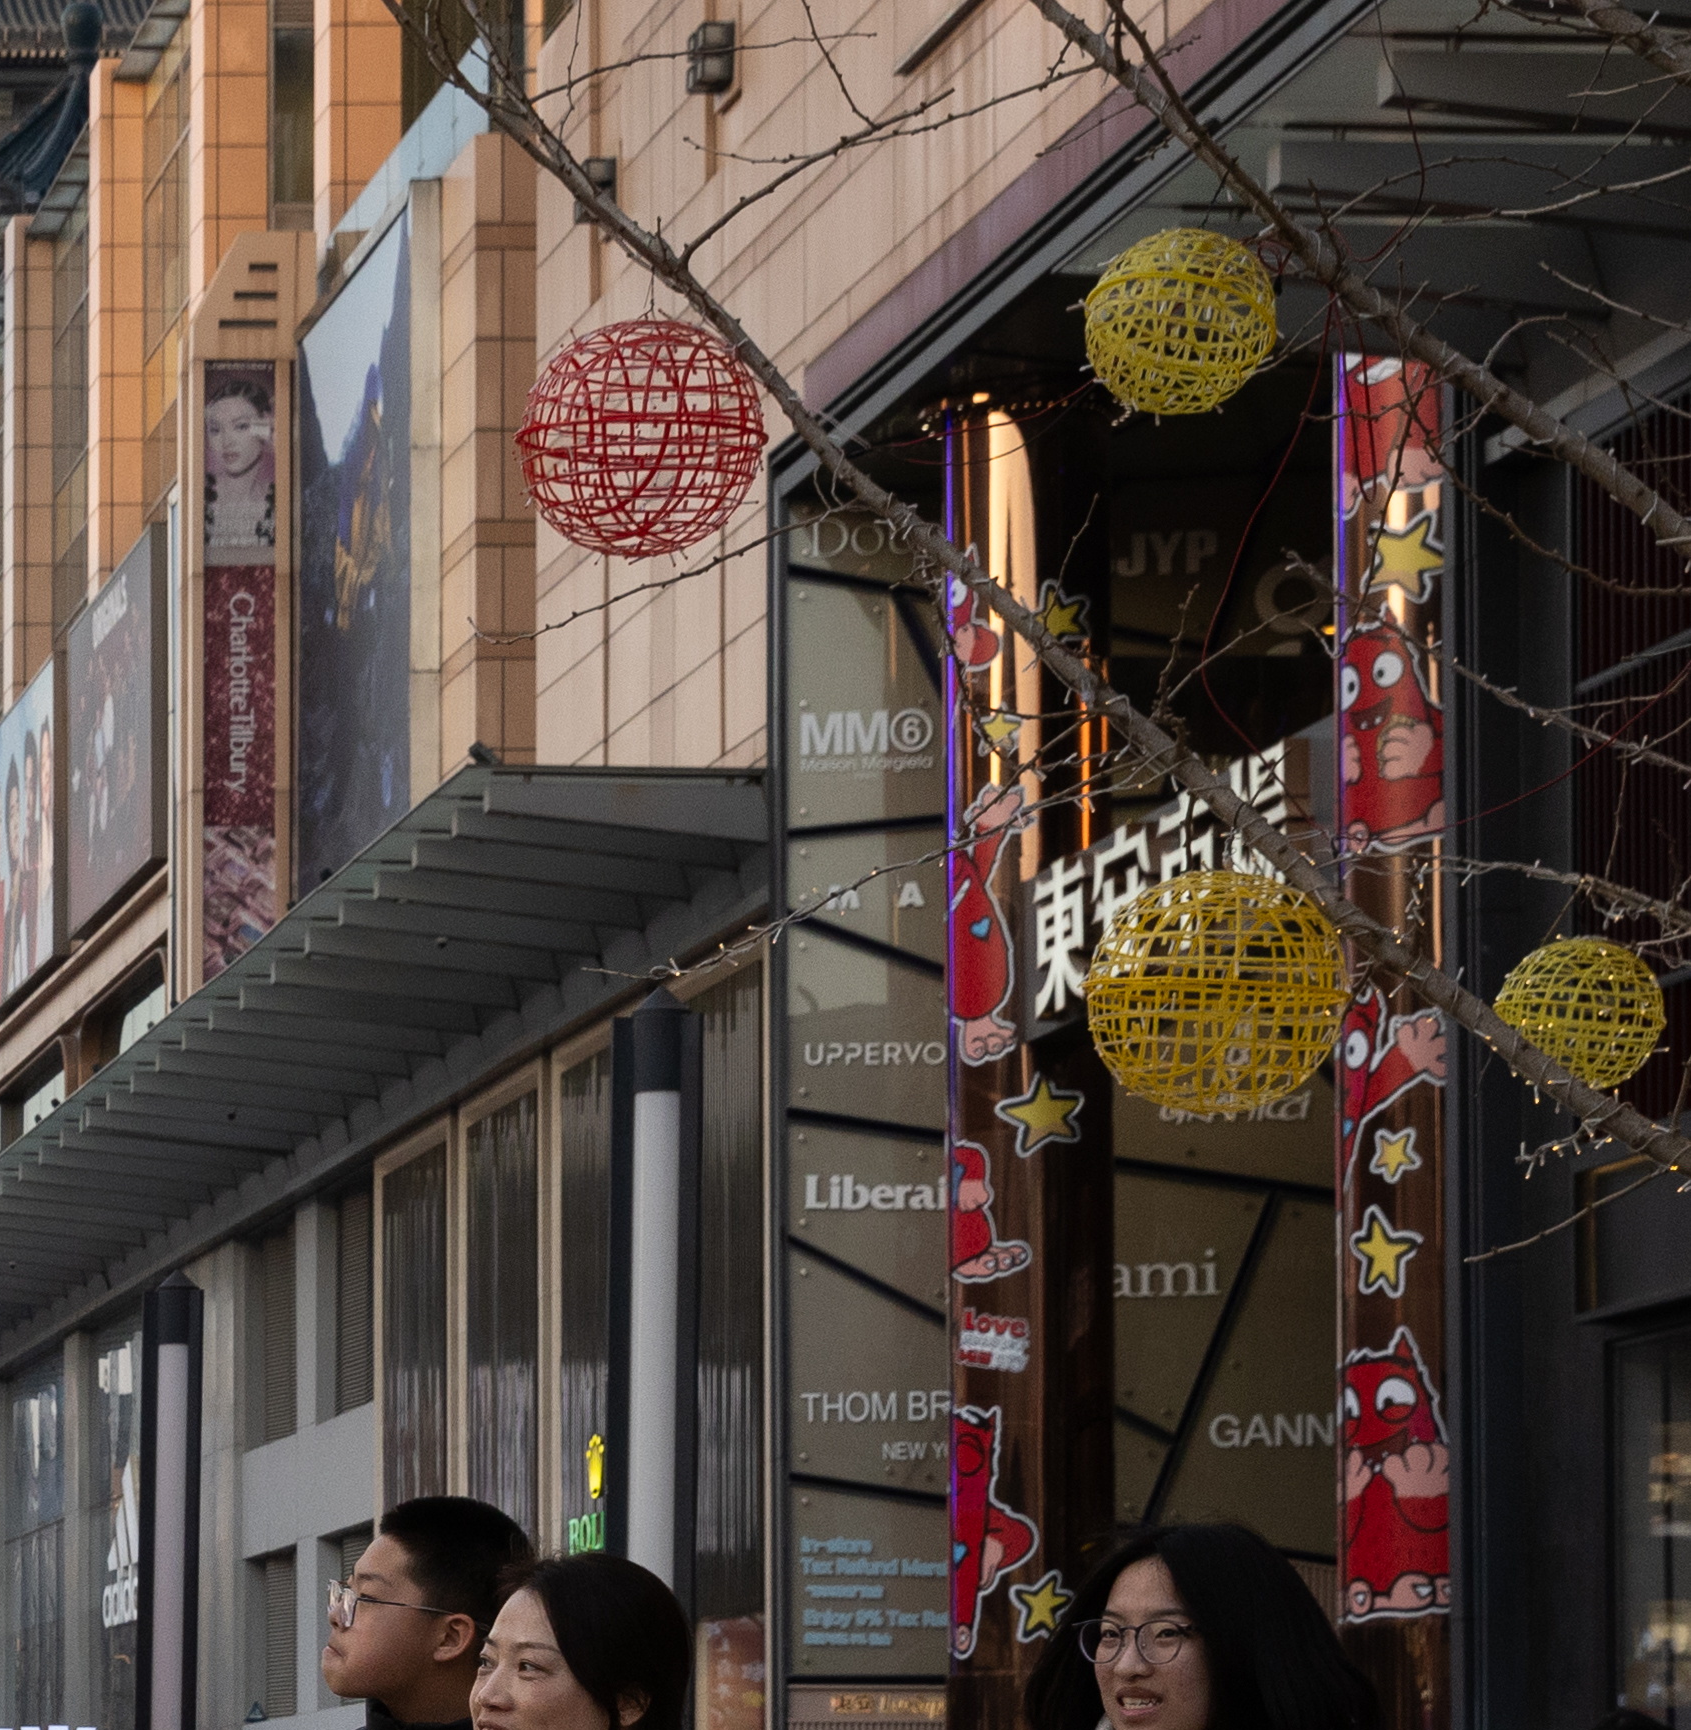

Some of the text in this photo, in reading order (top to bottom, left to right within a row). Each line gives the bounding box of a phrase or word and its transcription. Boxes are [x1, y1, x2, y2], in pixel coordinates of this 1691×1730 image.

[223, 591, 257, 794] Charlotte Tilbury
[1113, 1246, 1219, 1298] ami
[799, 1391, 898, 1423] THOM
[881, 1441, 927, 1461] NEW
